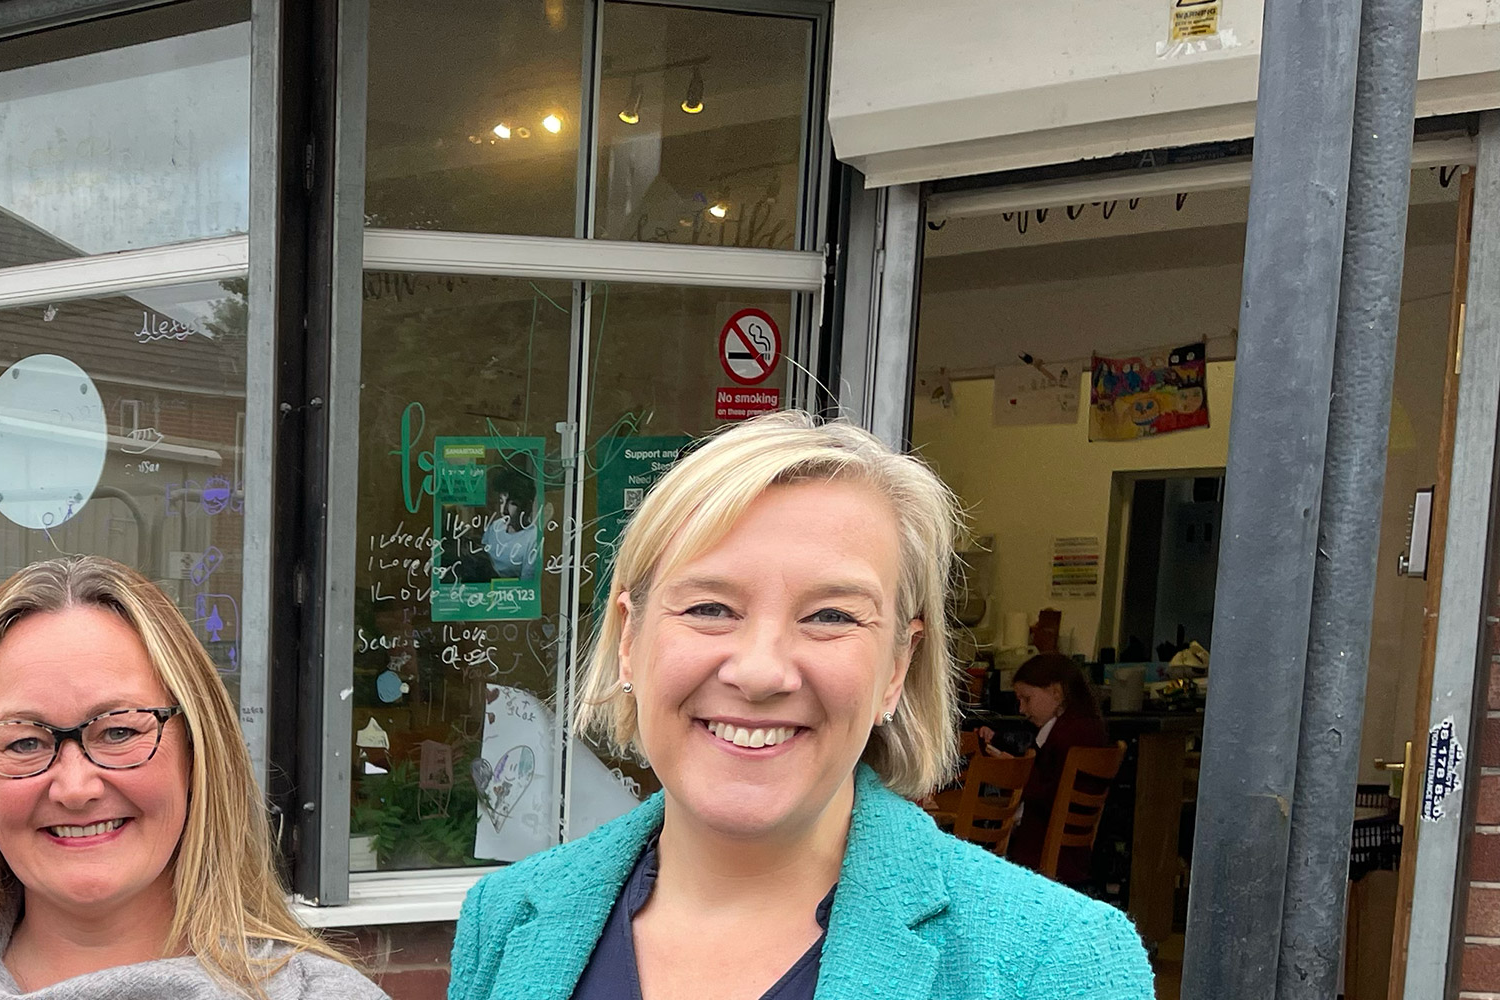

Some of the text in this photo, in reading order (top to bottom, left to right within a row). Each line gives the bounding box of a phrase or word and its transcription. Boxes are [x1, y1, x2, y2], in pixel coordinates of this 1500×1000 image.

[1175, 8, 1216, 19] WARNING
[718, 392, 778, 407] No smoking
[728, 408, 746, 416] these
[625, 449, 679, 460] Support and
[628, 475, 652, 485] Need
[517, 589, 535, 601] 123
[1436, 746, 1448, 778] 178
